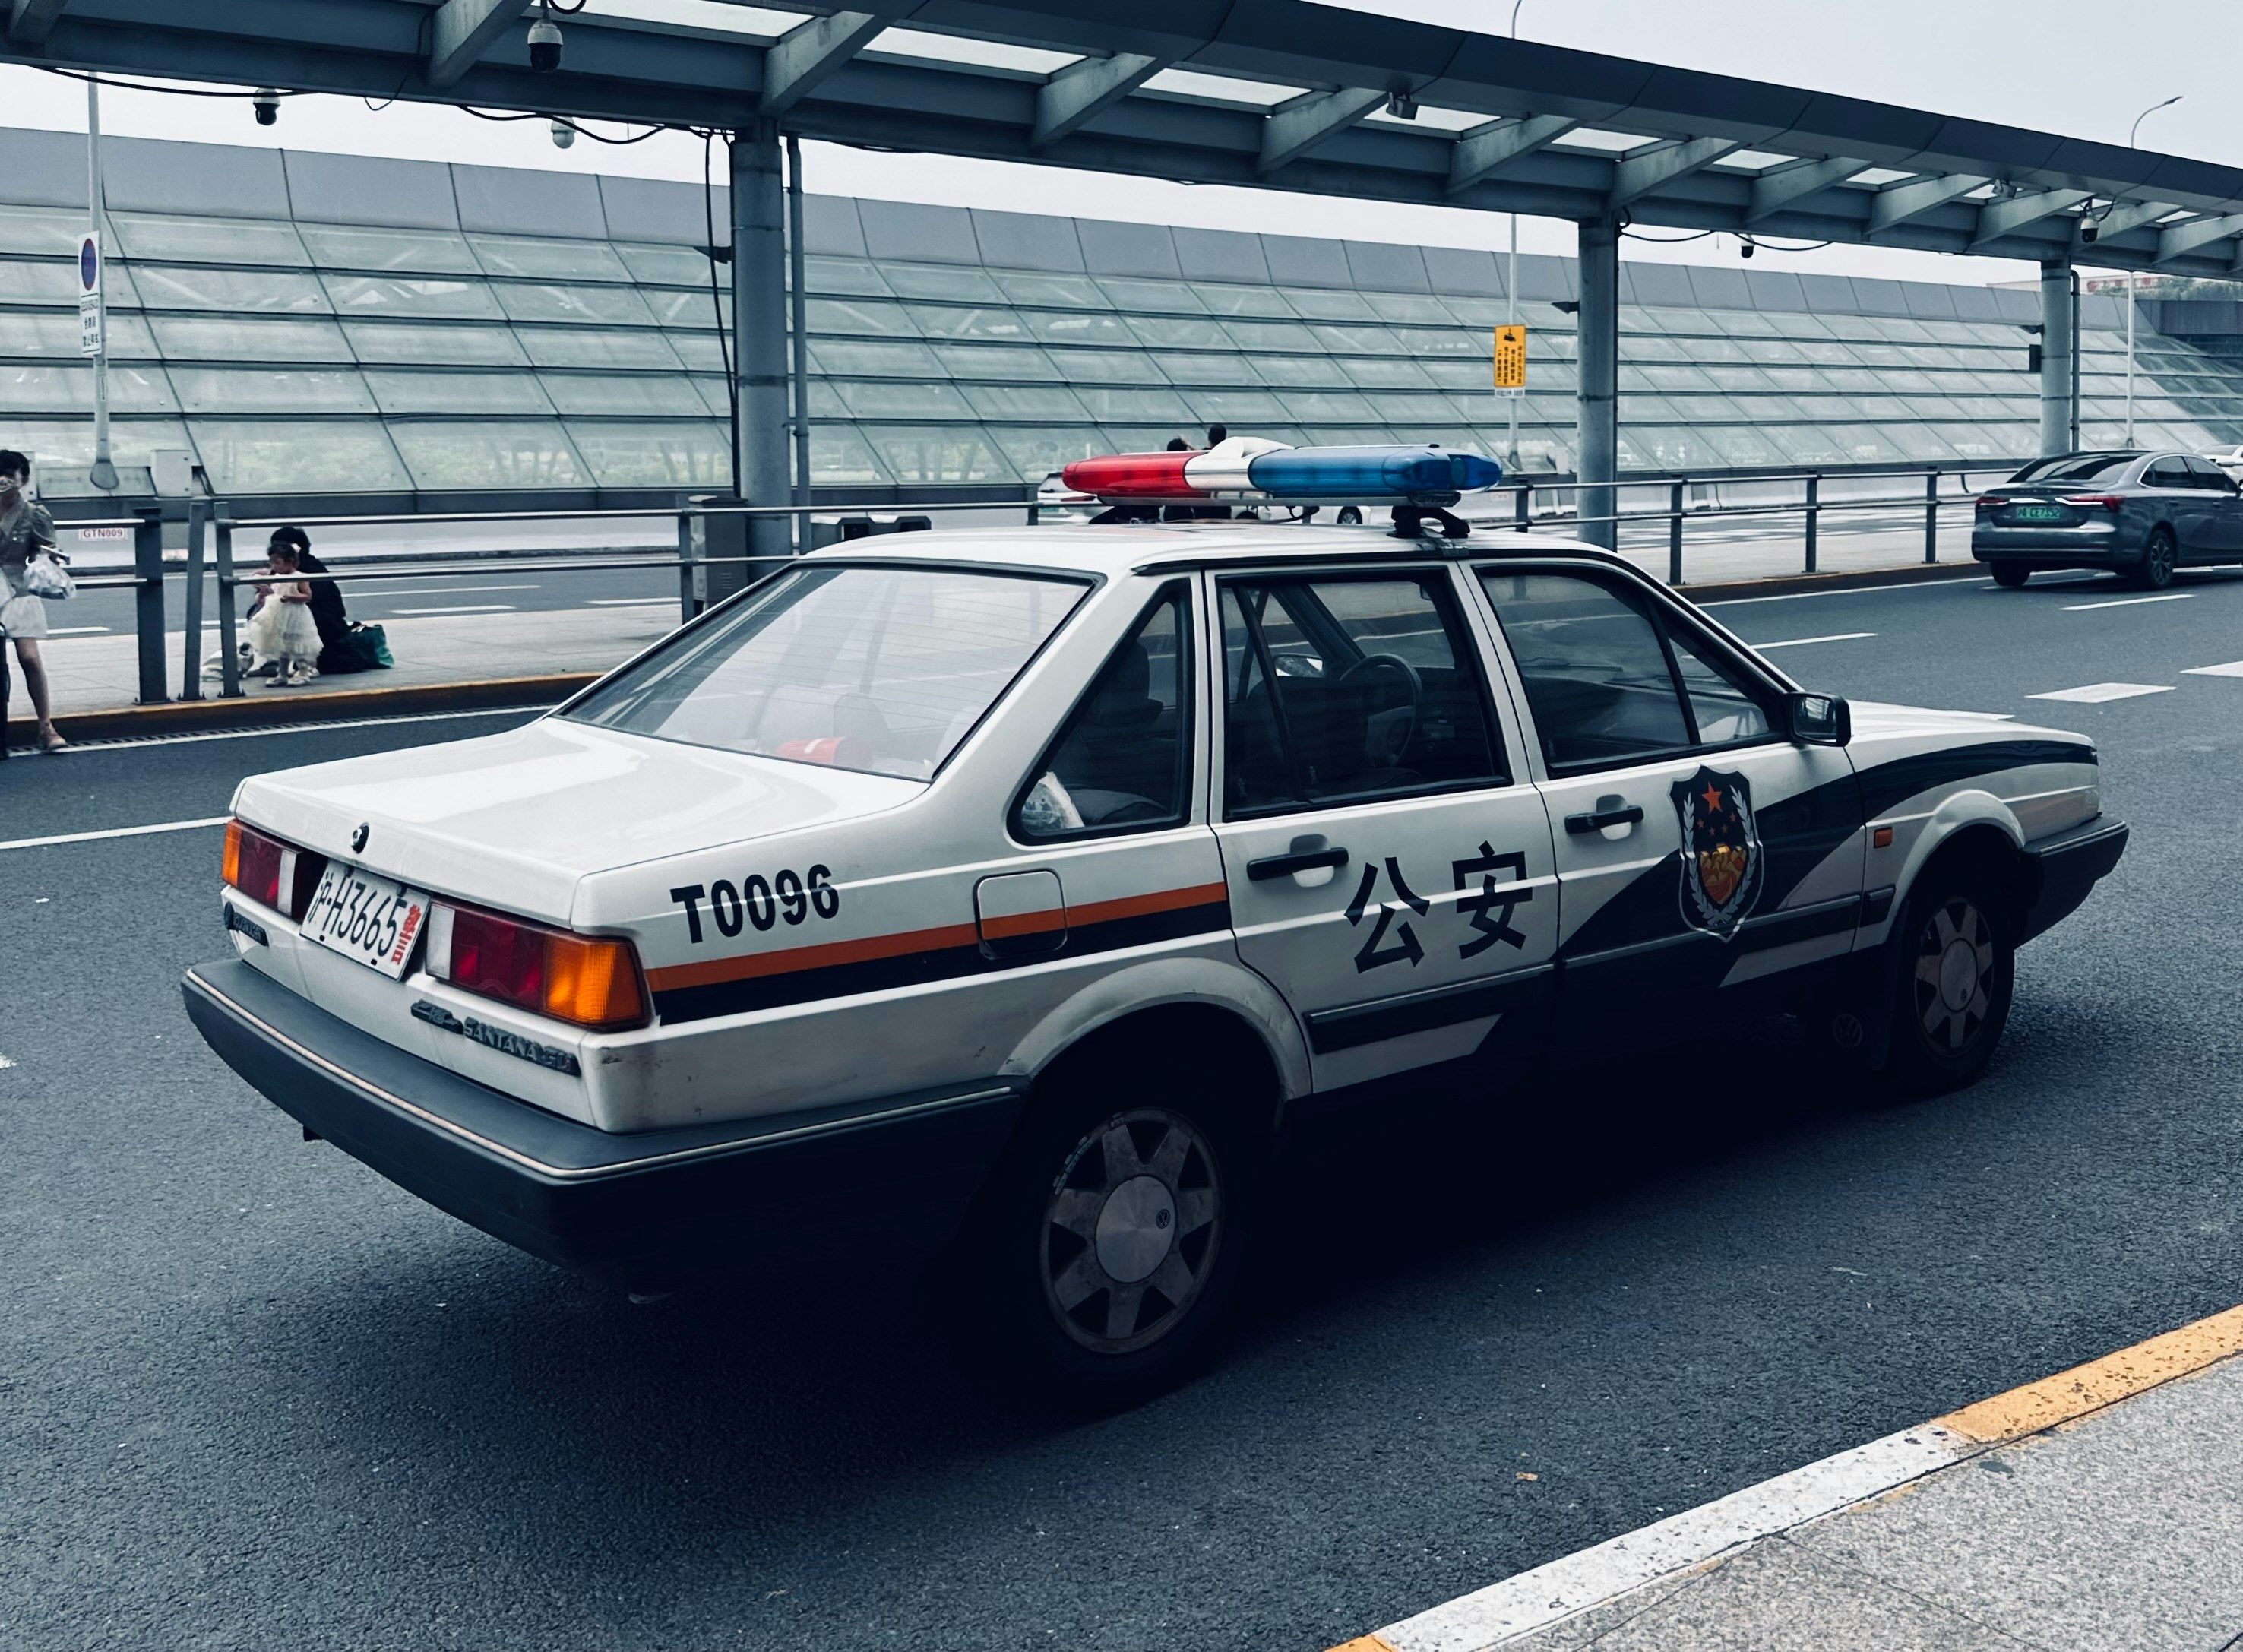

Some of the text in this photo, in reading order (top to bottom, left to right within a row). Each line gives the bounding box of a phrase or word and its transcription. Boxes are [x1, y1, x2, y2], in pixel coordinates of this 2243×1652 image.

[84, 529, 122, 537] GTN009
[669, 864, 839, 943] T0096
[1344, 840, 1533, 973] 公安
